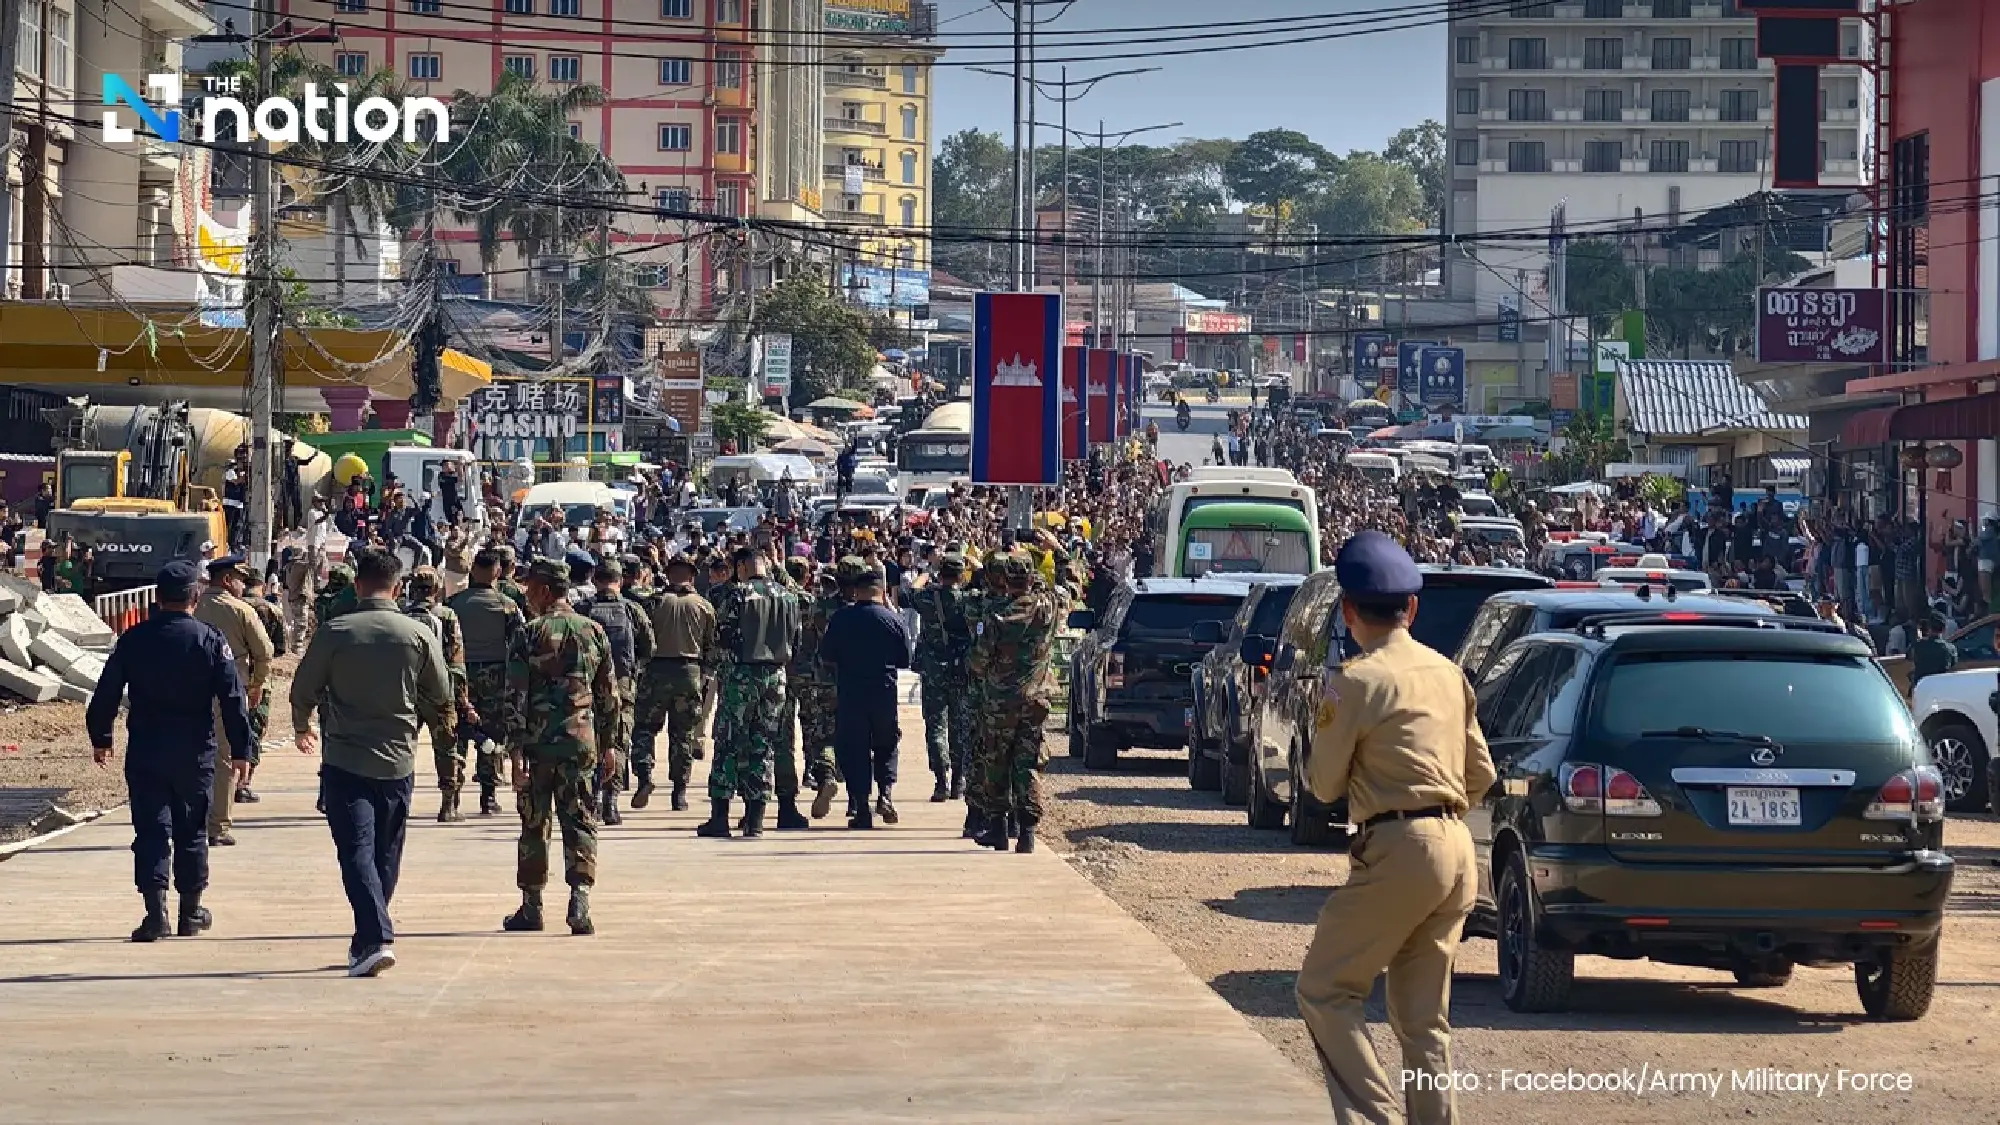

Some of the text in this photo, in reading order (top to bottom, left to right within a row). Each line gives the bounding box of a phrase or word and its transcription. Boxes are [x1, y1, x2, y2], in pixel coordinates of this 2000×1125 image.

[485, 413, 577, 438] CASINO
[96, 543, 153, 553] VOLVO
[1731, 800, 1798, 819] 2A-1863
